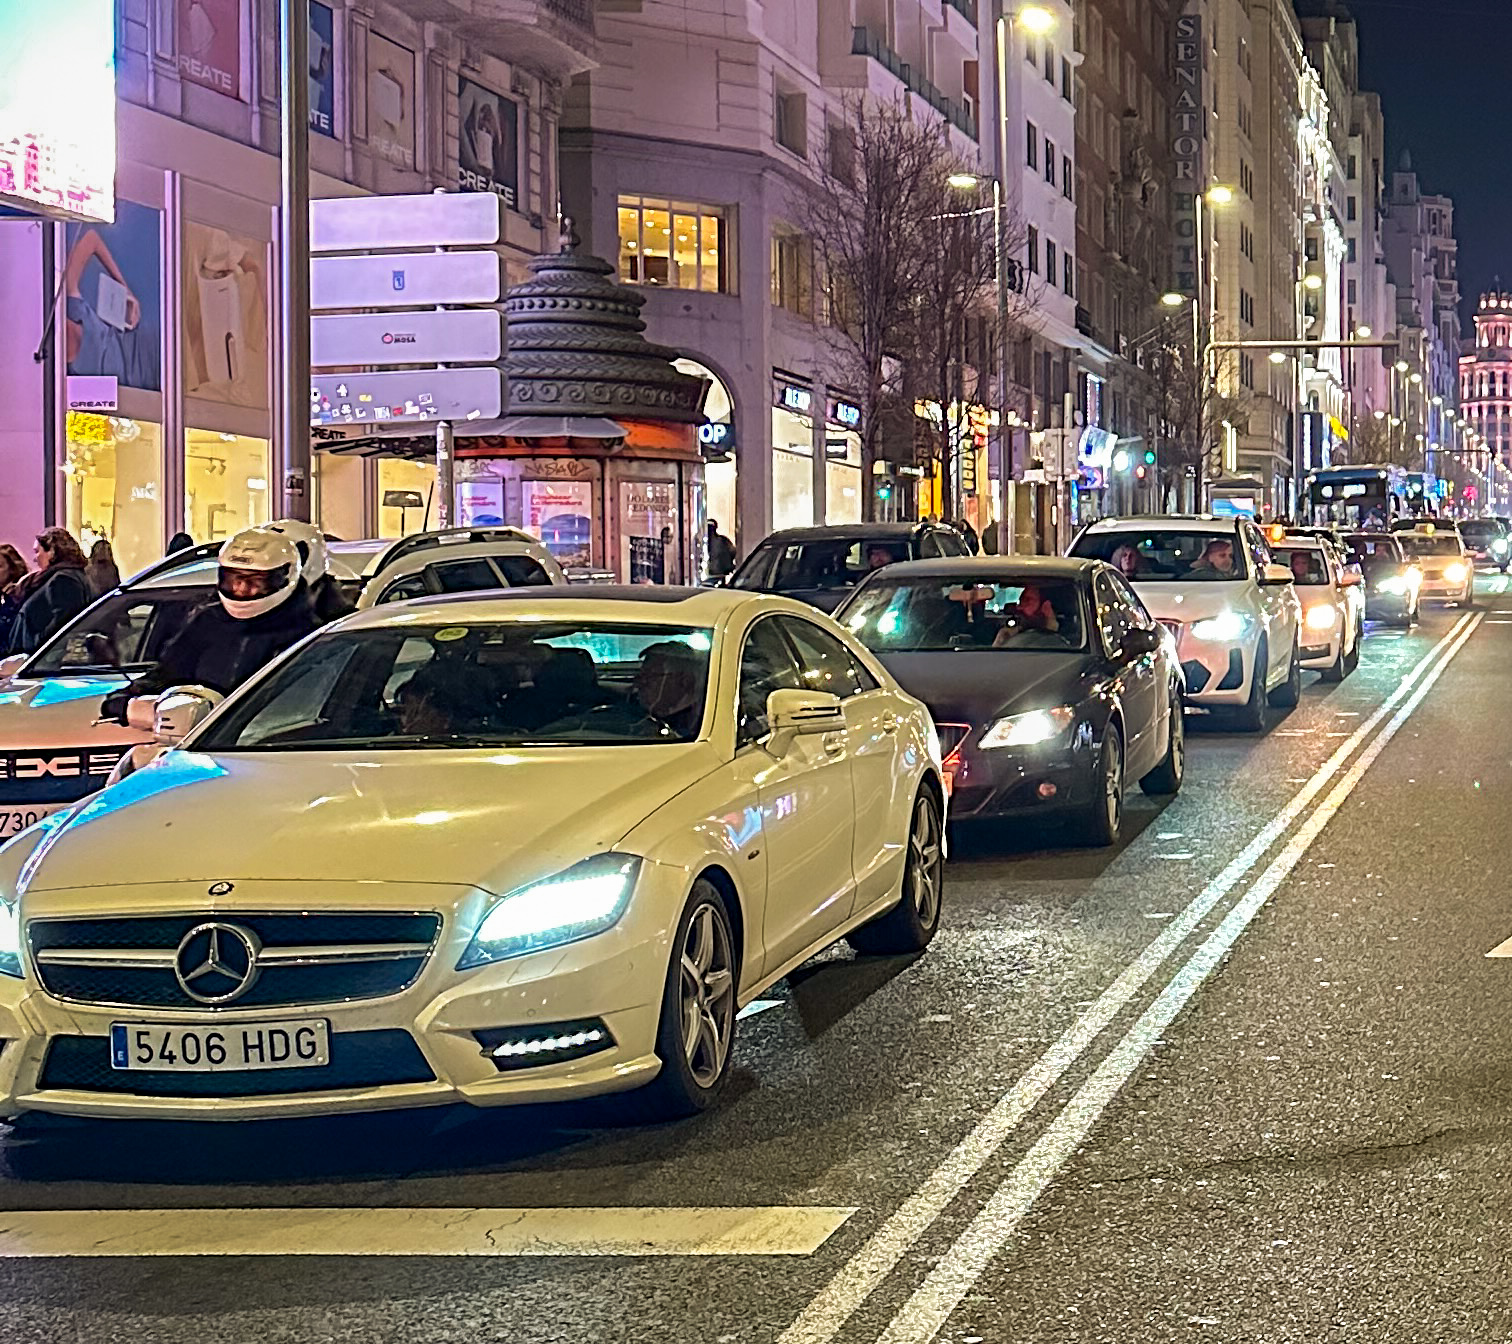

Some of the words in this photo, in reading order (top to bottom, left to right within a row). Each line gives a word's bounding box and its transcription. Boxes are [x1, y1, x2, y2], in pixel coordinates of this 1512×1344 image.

[1175, 17, 1199, 180] SENATOR
[458, 166, 514, 205] CREATE
[0, 810, 48, 834] 730
[117, 1051, 124, 1061] E
[136, 1030, 227, 1065] 5406
[242, 1027, 317, 1063] HDG
